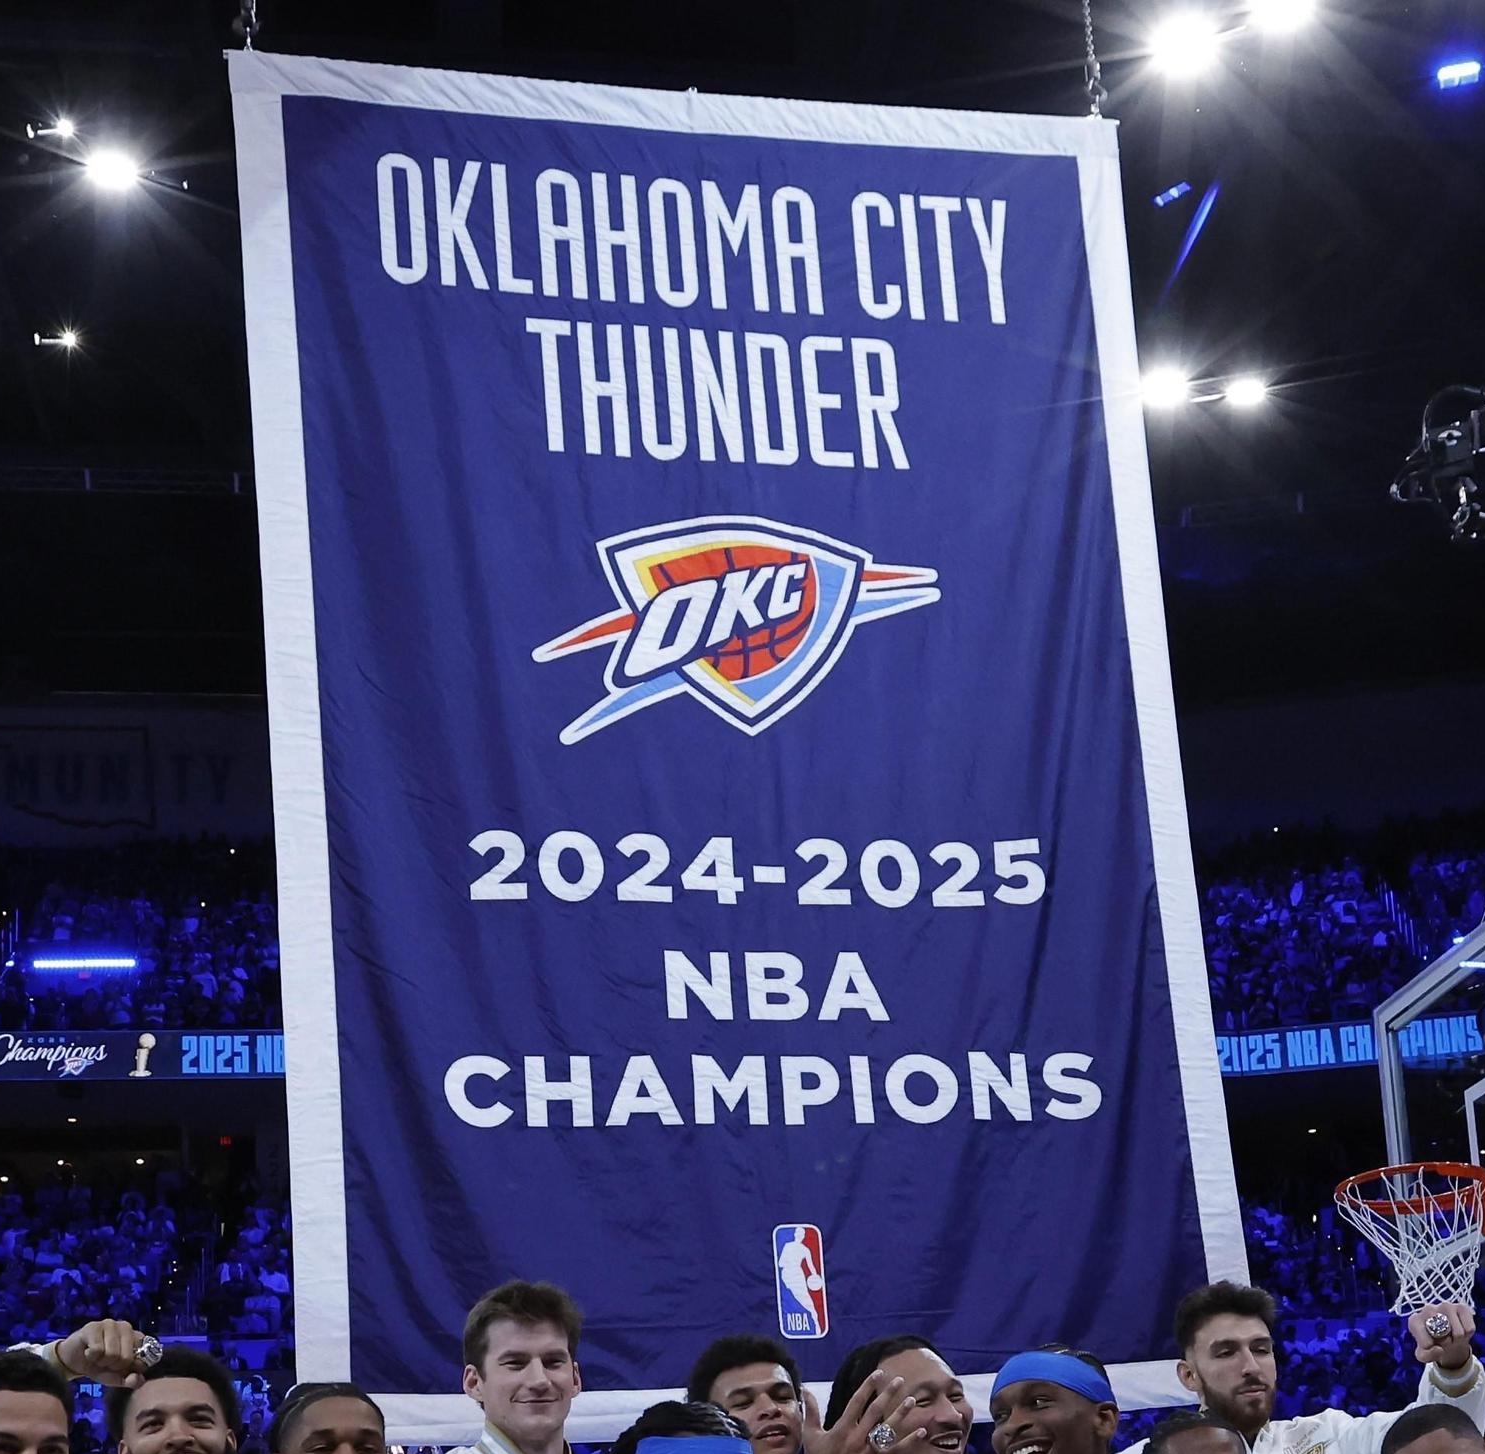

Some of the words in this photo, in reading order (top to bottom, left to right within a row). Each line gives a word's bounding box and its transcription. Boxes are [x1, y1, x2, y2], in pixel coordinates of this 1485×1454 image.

[376, 152, 824, 316] OKLAHOMA
[851, 191, 1007, 325] CITY
[525, 317, 910, 470] THUNDER
[624, 558, 805, 677] OKC
[468, 830, 1047, 910] 2024-2025
[665, 950, 891, 1022] NBA
[182, 1035, 250, 1074] 2025
[256, 1035, 285, 1073] NB
[1286, 1028, 1335, 1067] NBA
[1340, 1016, 1483, 1063] CHMPIONS
[443, 1051, 1102, 1128] CHAMPIONS
[787, 1312, 811, 1331] NBA
